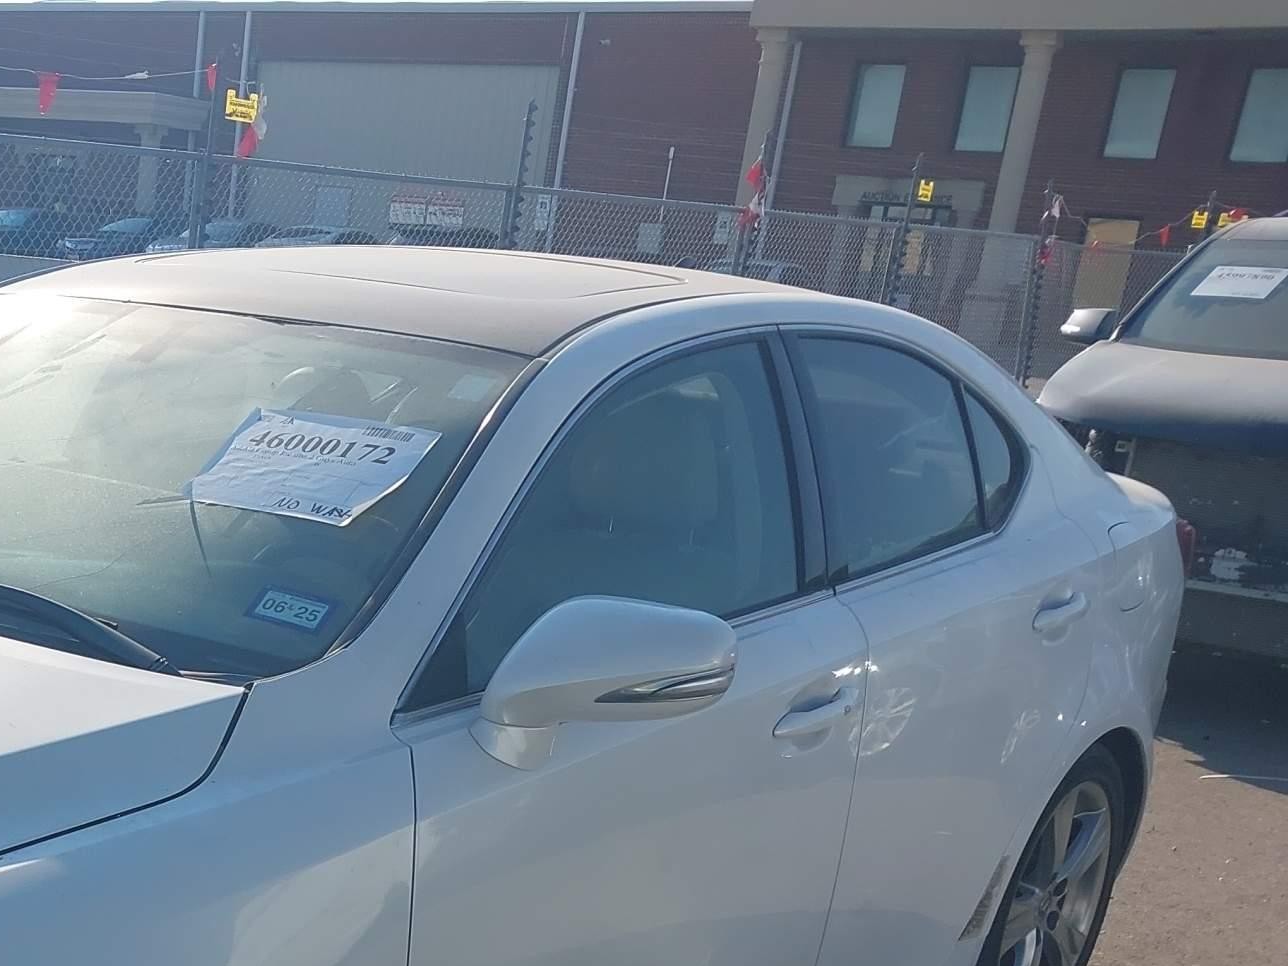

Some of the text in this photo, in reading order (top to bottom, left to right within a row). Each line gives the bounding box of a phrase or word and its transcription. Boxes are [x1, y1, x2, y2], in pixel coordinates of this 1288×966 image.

[249, 430, 396, 465] 46000172
[272, 497, 300, 510] NO
[262, 598, 321, 622] 06 25
